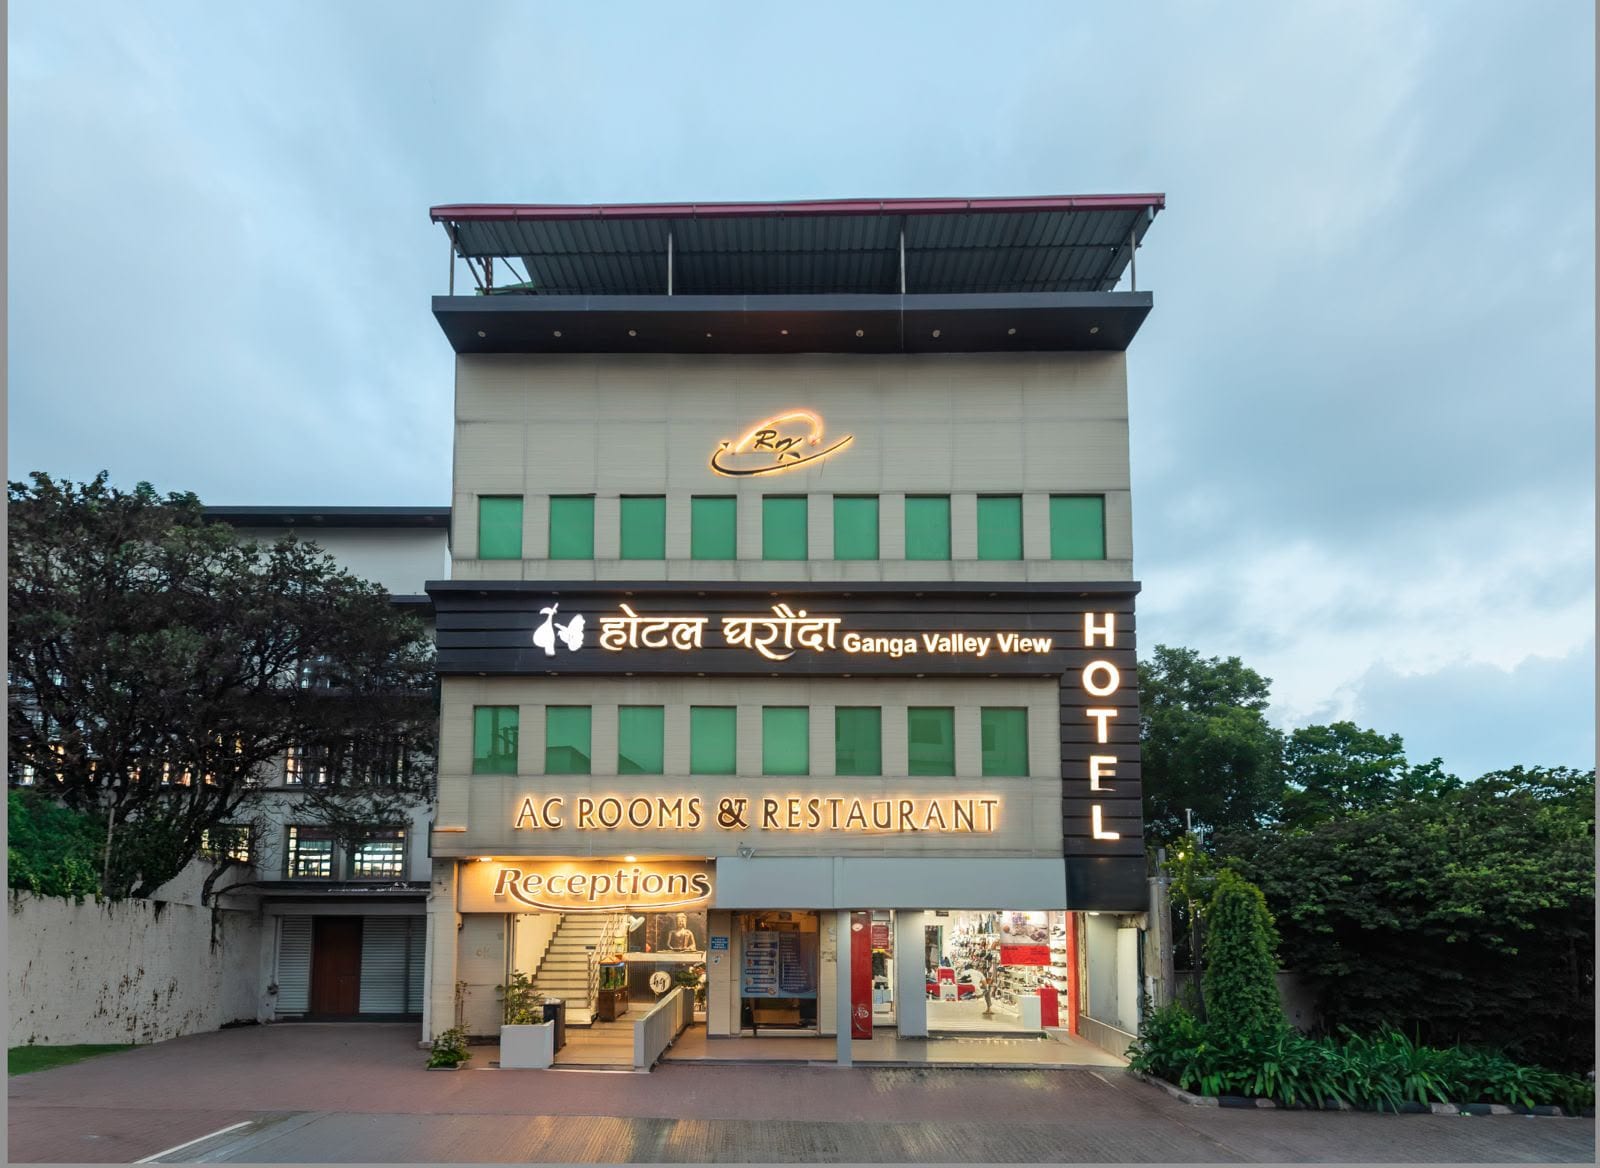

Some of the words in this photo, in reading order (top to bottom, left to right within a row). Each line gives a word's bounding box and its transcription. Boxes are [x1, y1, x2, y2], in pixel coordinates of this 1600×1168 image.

[600, 603, 709, 651] होटल
[722, 603, 842, 661] घरौंदा
[843, 633, 918, 658] Ganga
[922, 633, 991, 657] Valley
[997, 633, 1053, 653] View
[1082, 612, 1121, 840] HOTEL
[515, 796, 564, 829] AC
[577, 796, 703, 830] ROOMS
[716, 797, 749, 830] &
[762, 796, 1000, 833] RESTAURANT
[494, 866, 713, 911] Receptions
